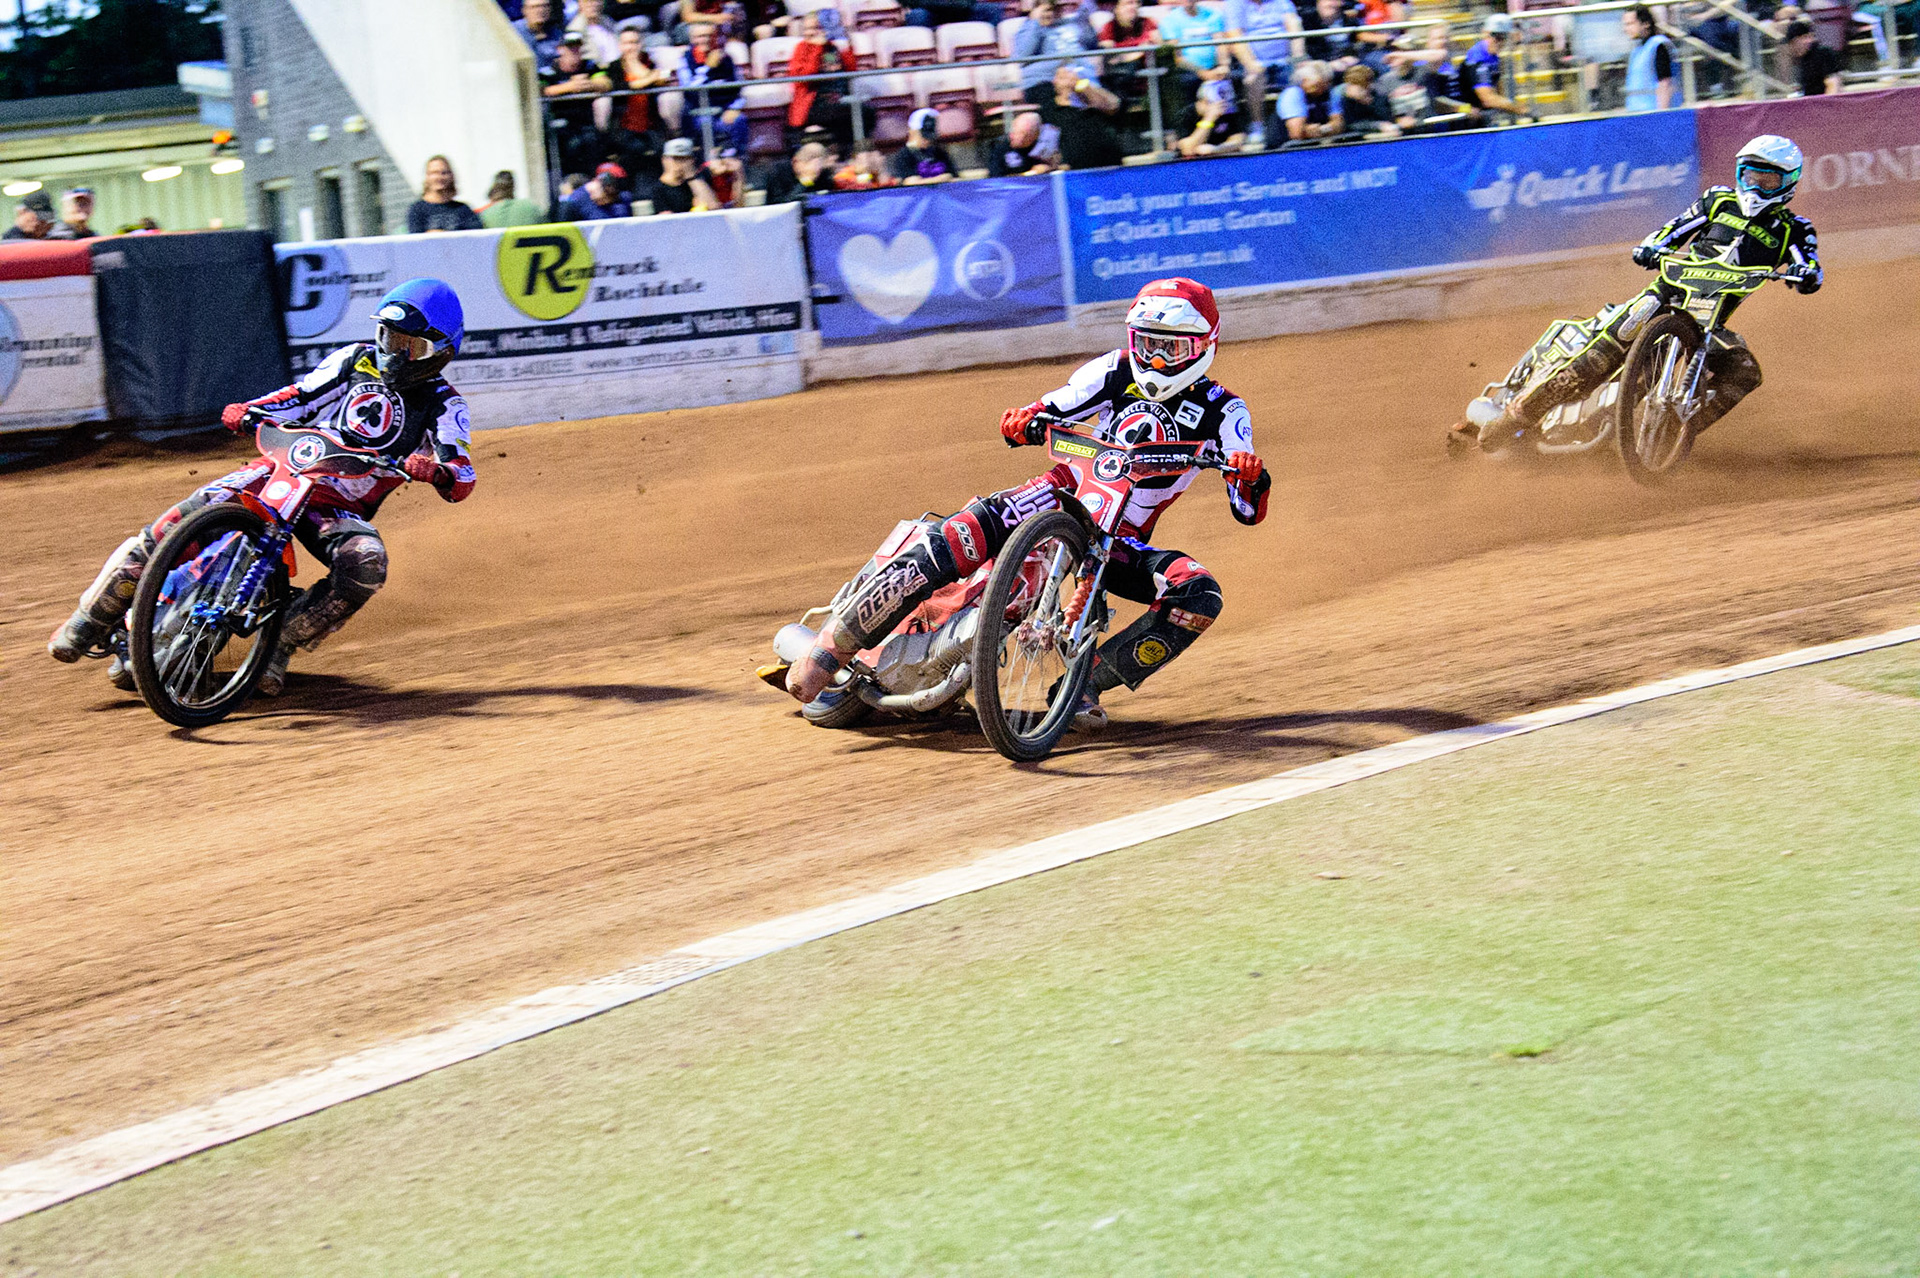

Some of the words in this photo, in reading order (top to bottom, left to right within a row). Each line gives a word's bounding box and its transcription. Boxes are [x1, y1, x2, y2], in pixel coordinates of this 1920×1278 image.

[1086, 193, 1136, 215] Book
[1140, 194, 1184, 215] your
[1187, 187, 1232, 207] next
[1234, 178, 1308, 201] Service
[1310, 172, 1347, 194] and
[1515, 163, 1608, 208] Quick
[1609, 160, 1691, 194] Lane
[1111, 219, 1170, 243] Quick
[1173, 215, 1222, 235] Lane
[1224, 209, 1297, 231] Gorton
[350, 385, 379, 397] BELLE
[1120, 403, 1146, 419] BELLE
[1149, 404, 1168, 420] VUE
[1178, 406, 1200, 423] 5
